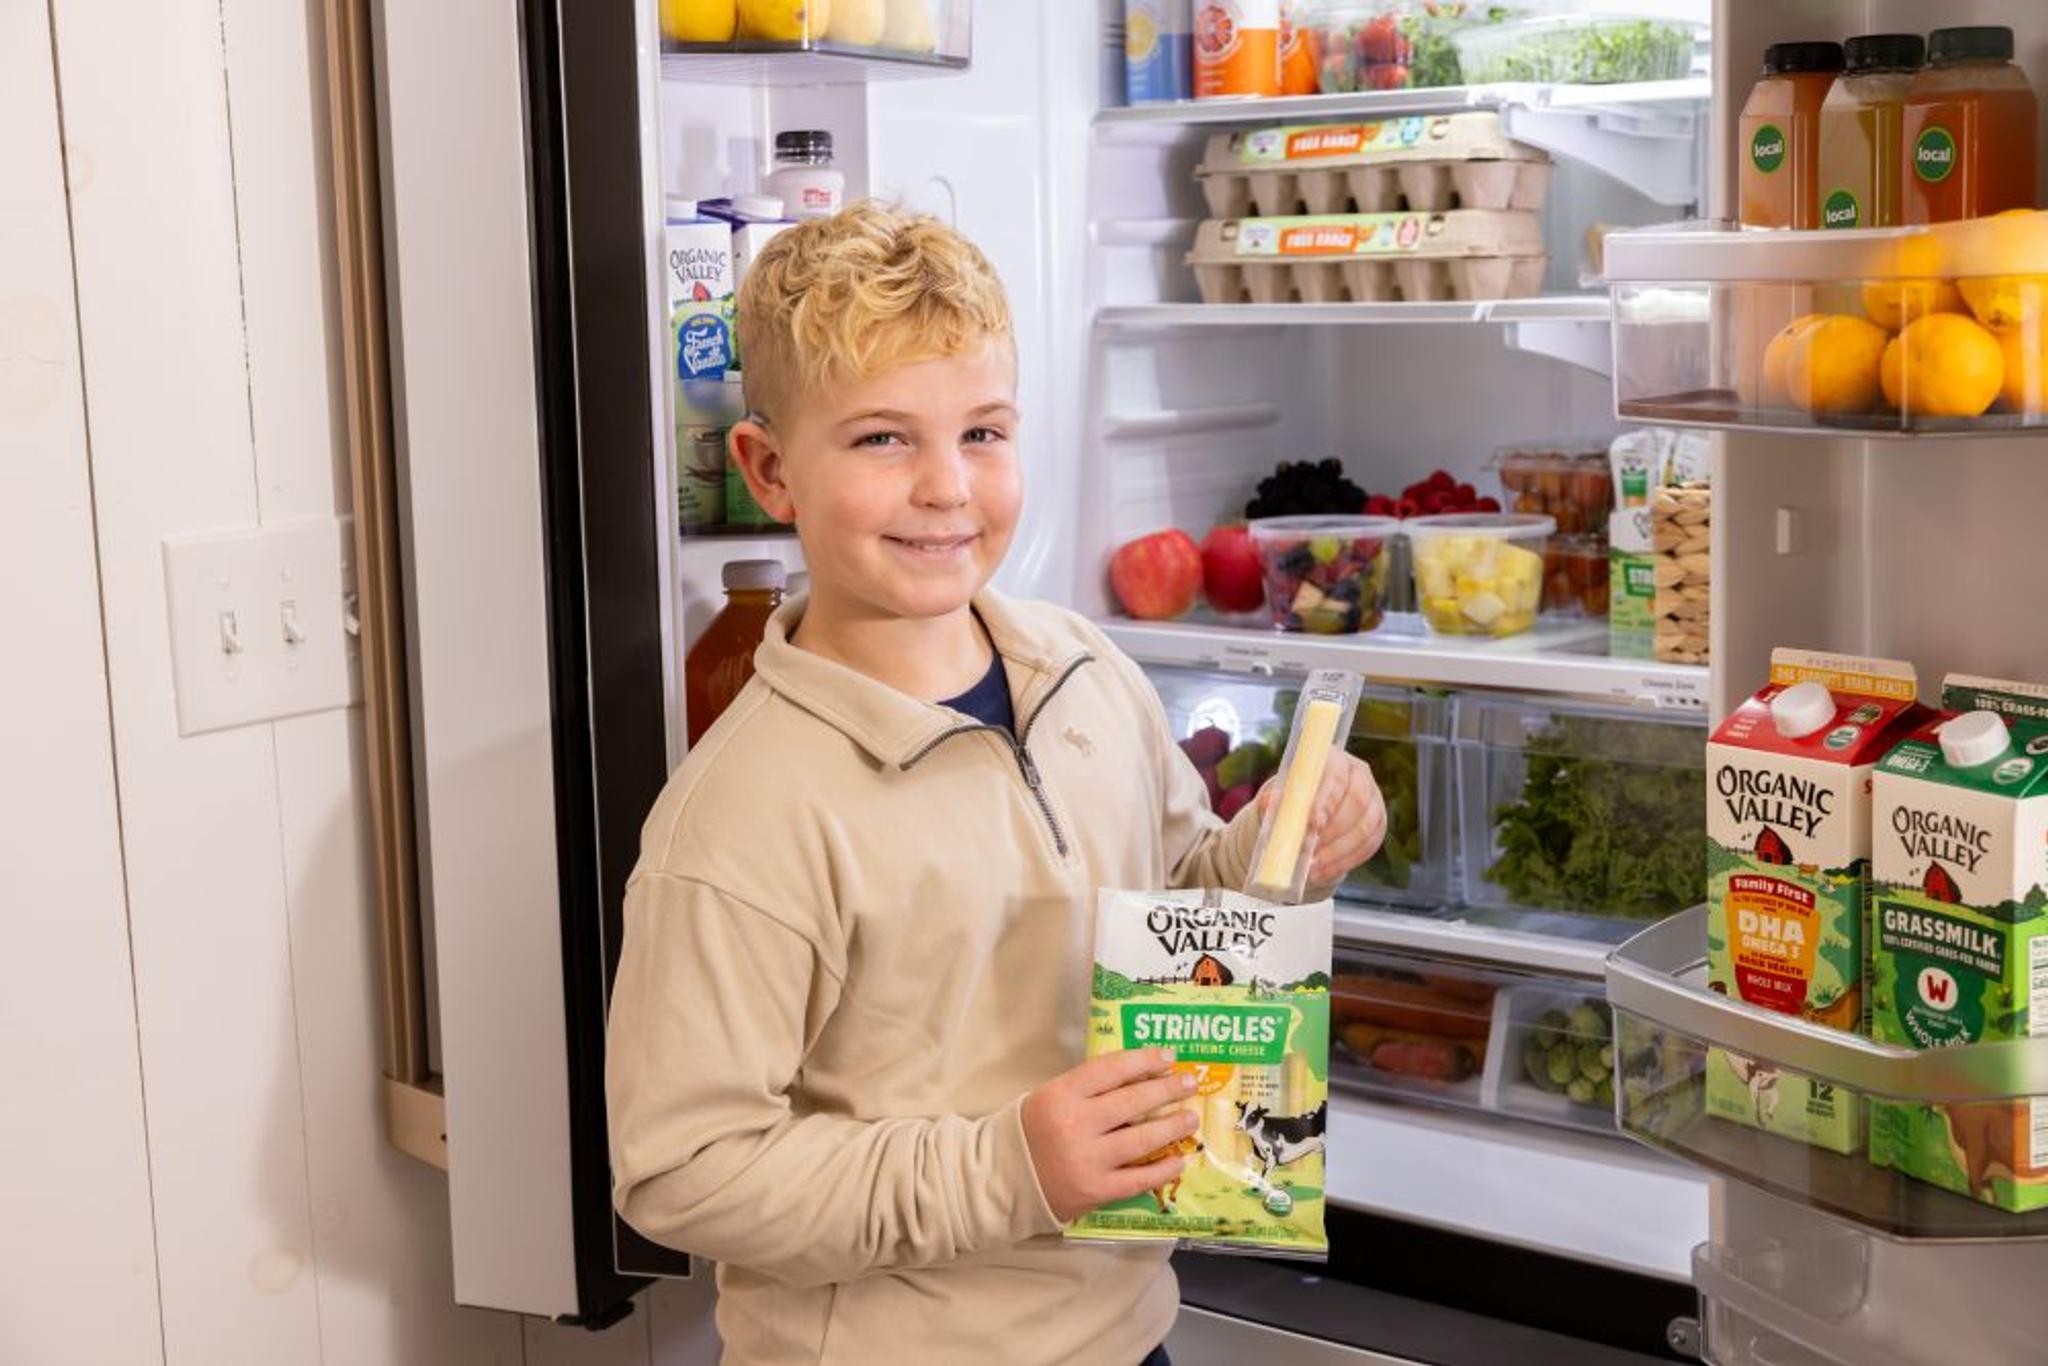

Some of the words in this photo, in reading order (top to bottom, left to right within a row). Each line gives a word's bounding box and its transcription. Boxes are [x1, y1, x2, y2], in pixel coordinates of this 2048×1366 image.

[1754, 139, 1783, 158] local
[1918, 147, 1951, 163] local
[1825, 204, 1856, 222] local
[670, 247, 727, 270] ORGANIC
[675, 264, 723, 285] VALLEY
[1716, 764, 1834, 816] ORGANIC
[1726, 795, 1823, 839] VALLEY
[1892, 805, 1993, 854] ORGANIC
[1900, 832, 1982, 874] VALLEY
[1734, 878, 1775, 894] Family
[1776, 883, 1810, 904] First
[1147, 904, 1276, 938] ORGANIC
[1738, 909, 1806, 946] DHA
[1884, 909, 1999, 958] GRASSMILK
[1156, 929, 1267, 958] VALLEY
[1742, 933, 1788, 958] OMEGA
[1767, 960, 1804, 976] HEALTH
[1746, 973, 1772, 989] WHOLE
[1773, 979, 1794, 993] MILK
[1927, 974, 1949, 1003] W
[1905, 1009, 1941, 1048] WHOLE
[1228, 1044, 1266, 1057] CHEESE
[1809, 1079, 1835, 1103] 12
